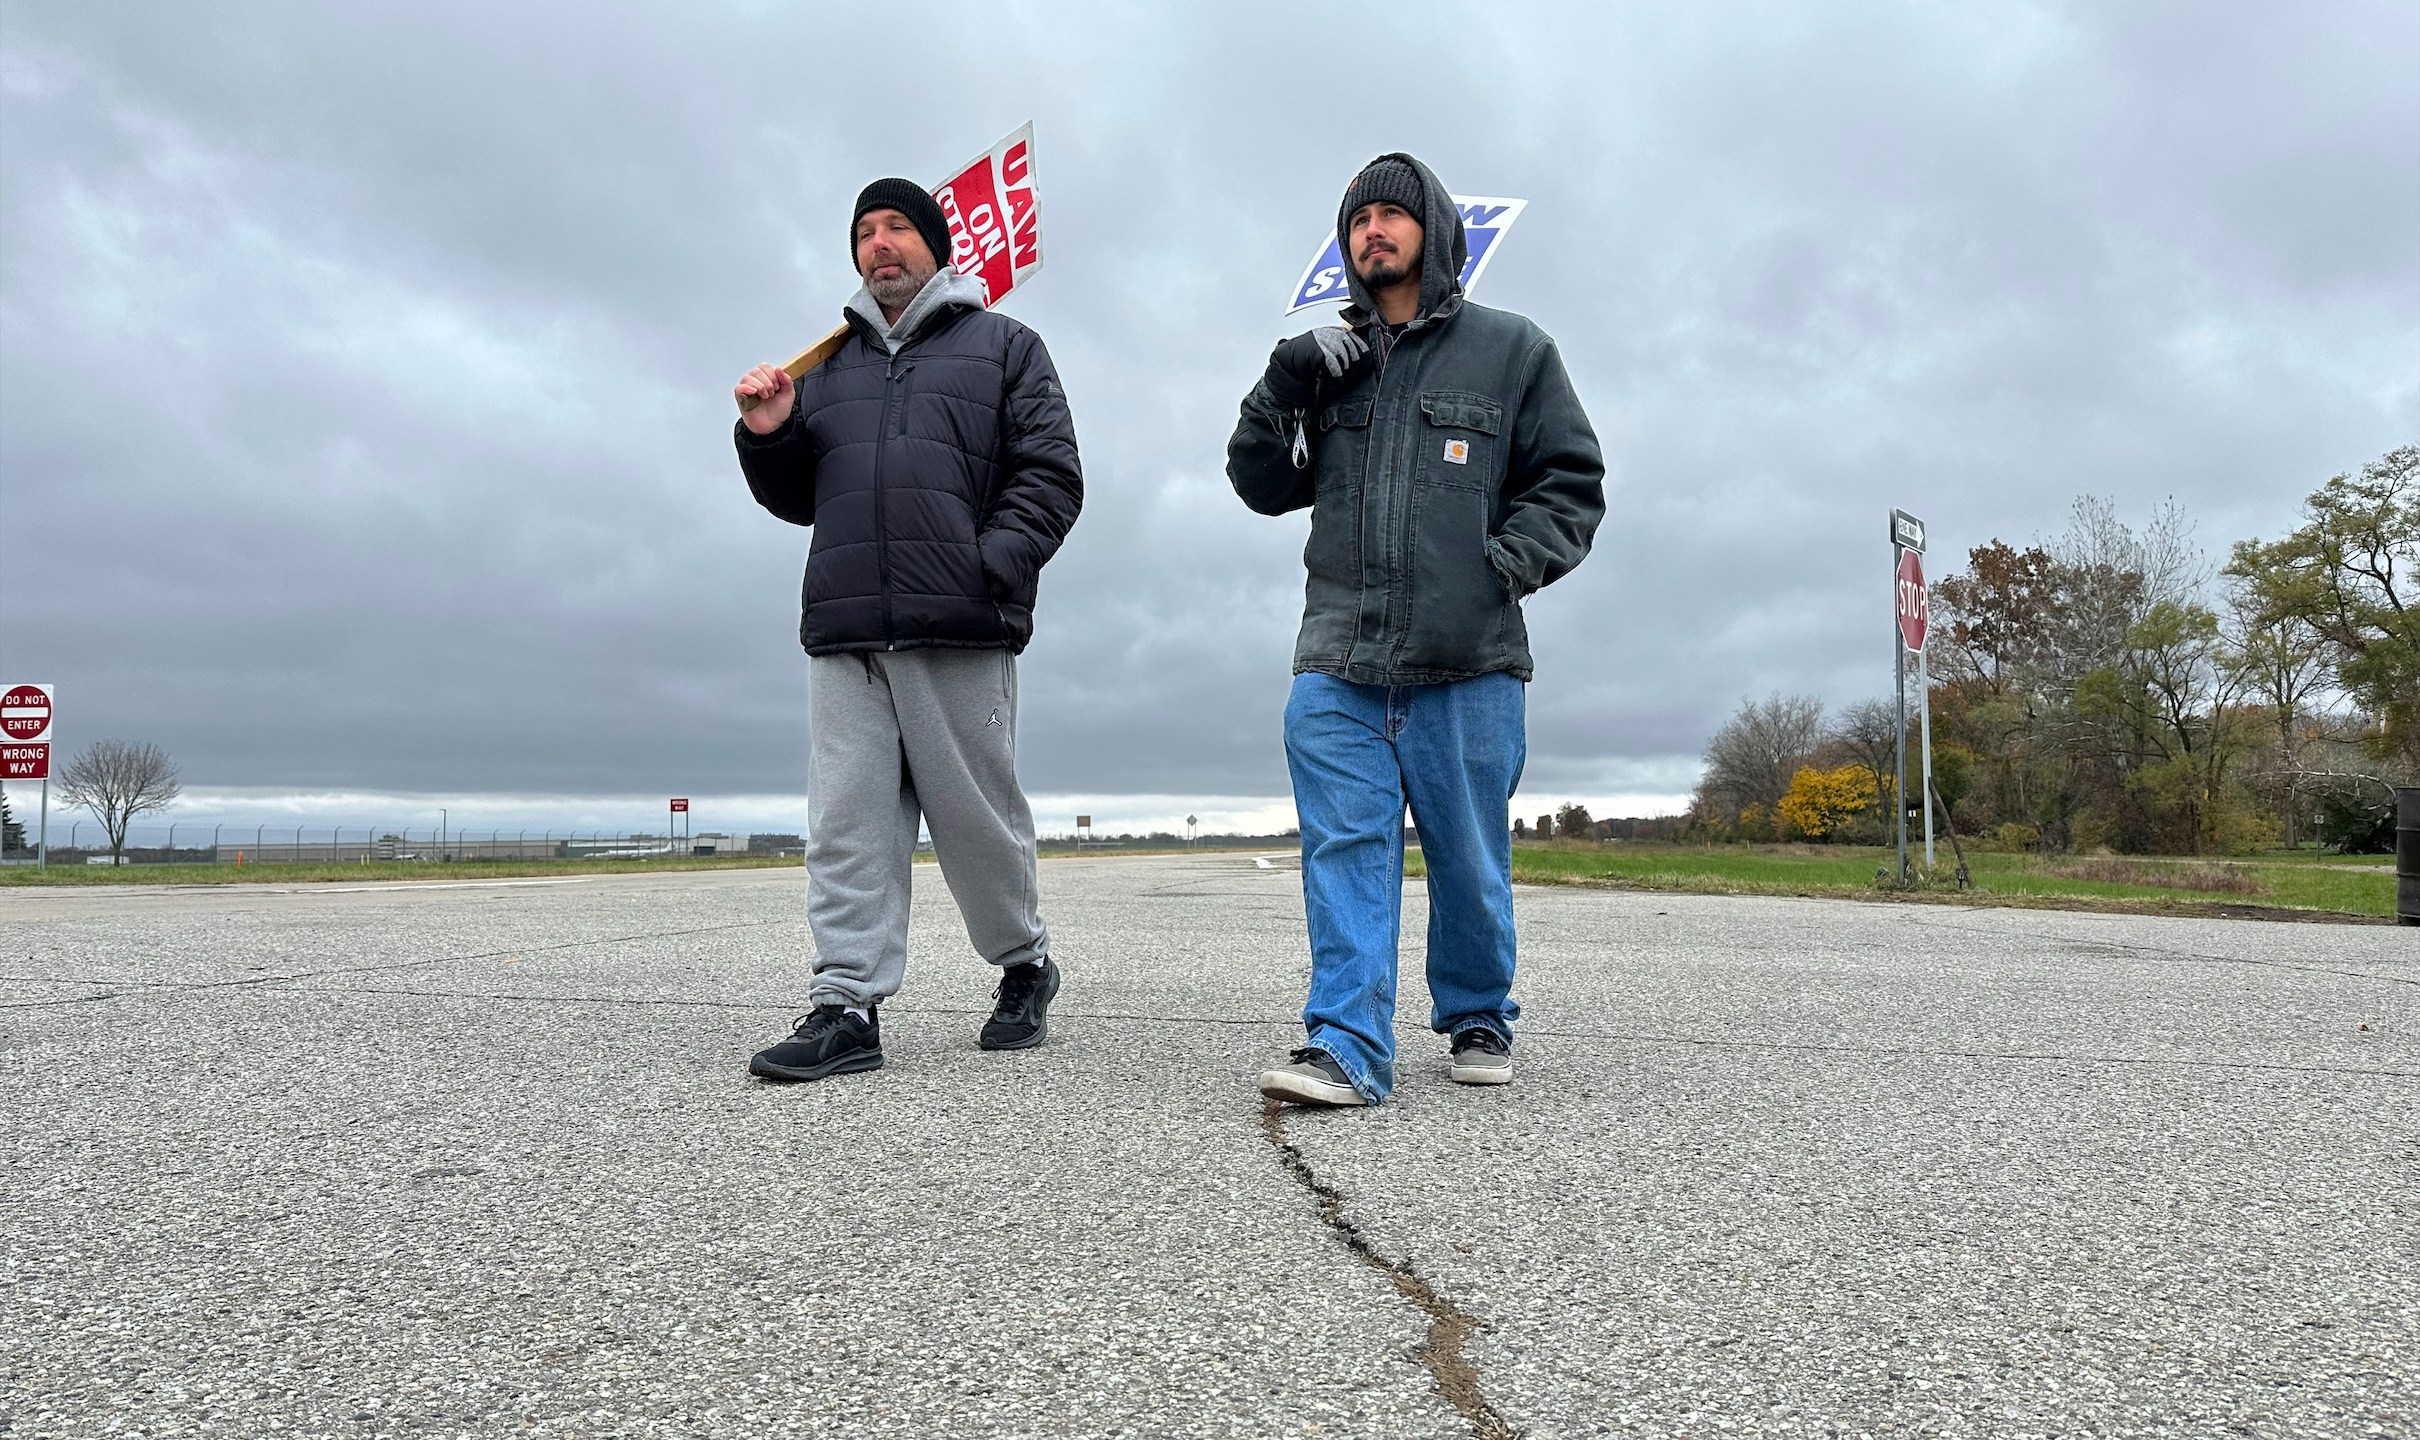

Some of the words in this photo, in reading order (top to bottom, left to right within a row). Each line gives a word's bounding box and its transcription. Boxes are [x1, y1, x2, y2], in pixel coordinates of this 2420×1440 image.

[1003, 139, 1038, 270] UAW
[968, 202, 1006, 262] ON
[1899, 578, 1926, 620] STOP
[5, 695, 20, 705] DO
[25, 695, 45, 705] NOT
[8, 720, 41, 730] ENTER
[2, 748, 44, 760] WRONG
[9, 762, 36, 774] WAY
